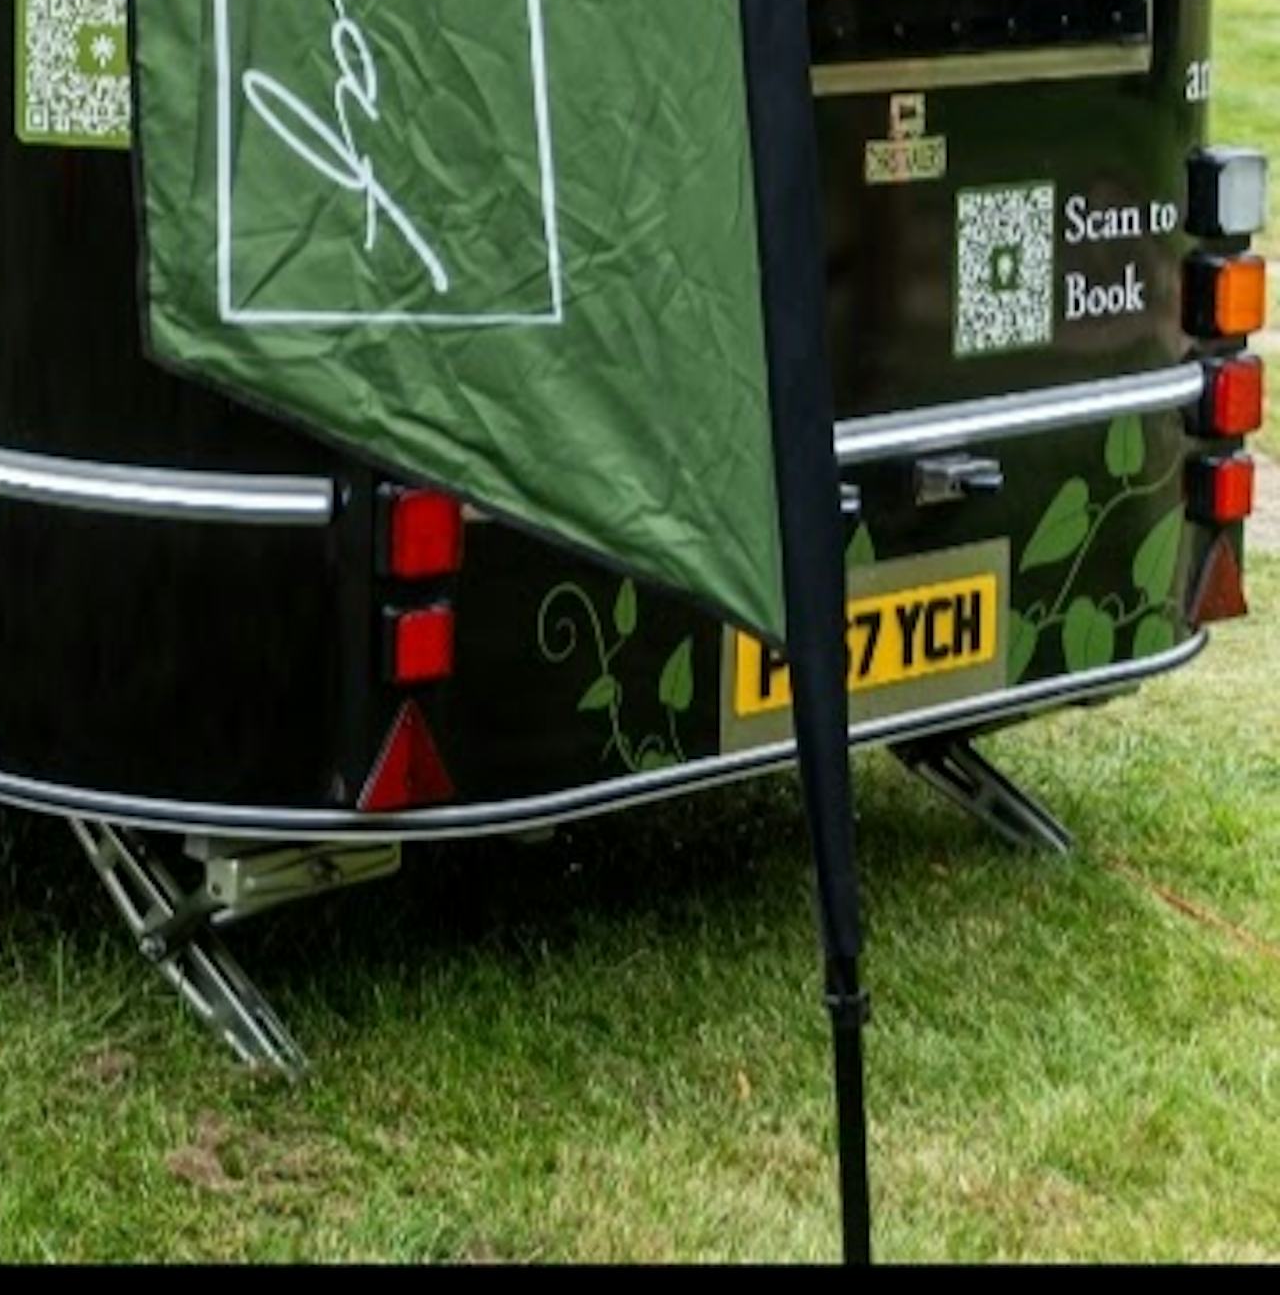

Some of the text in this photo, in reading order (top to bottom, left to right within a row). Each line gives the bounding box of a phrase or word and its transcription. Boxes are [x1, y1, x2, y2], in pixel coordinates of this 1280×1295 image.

[1065, 195, 1179, 243] Scan to
[1065, 262, 1145, 320] Book
[896, 590, 982, 669] YCH
